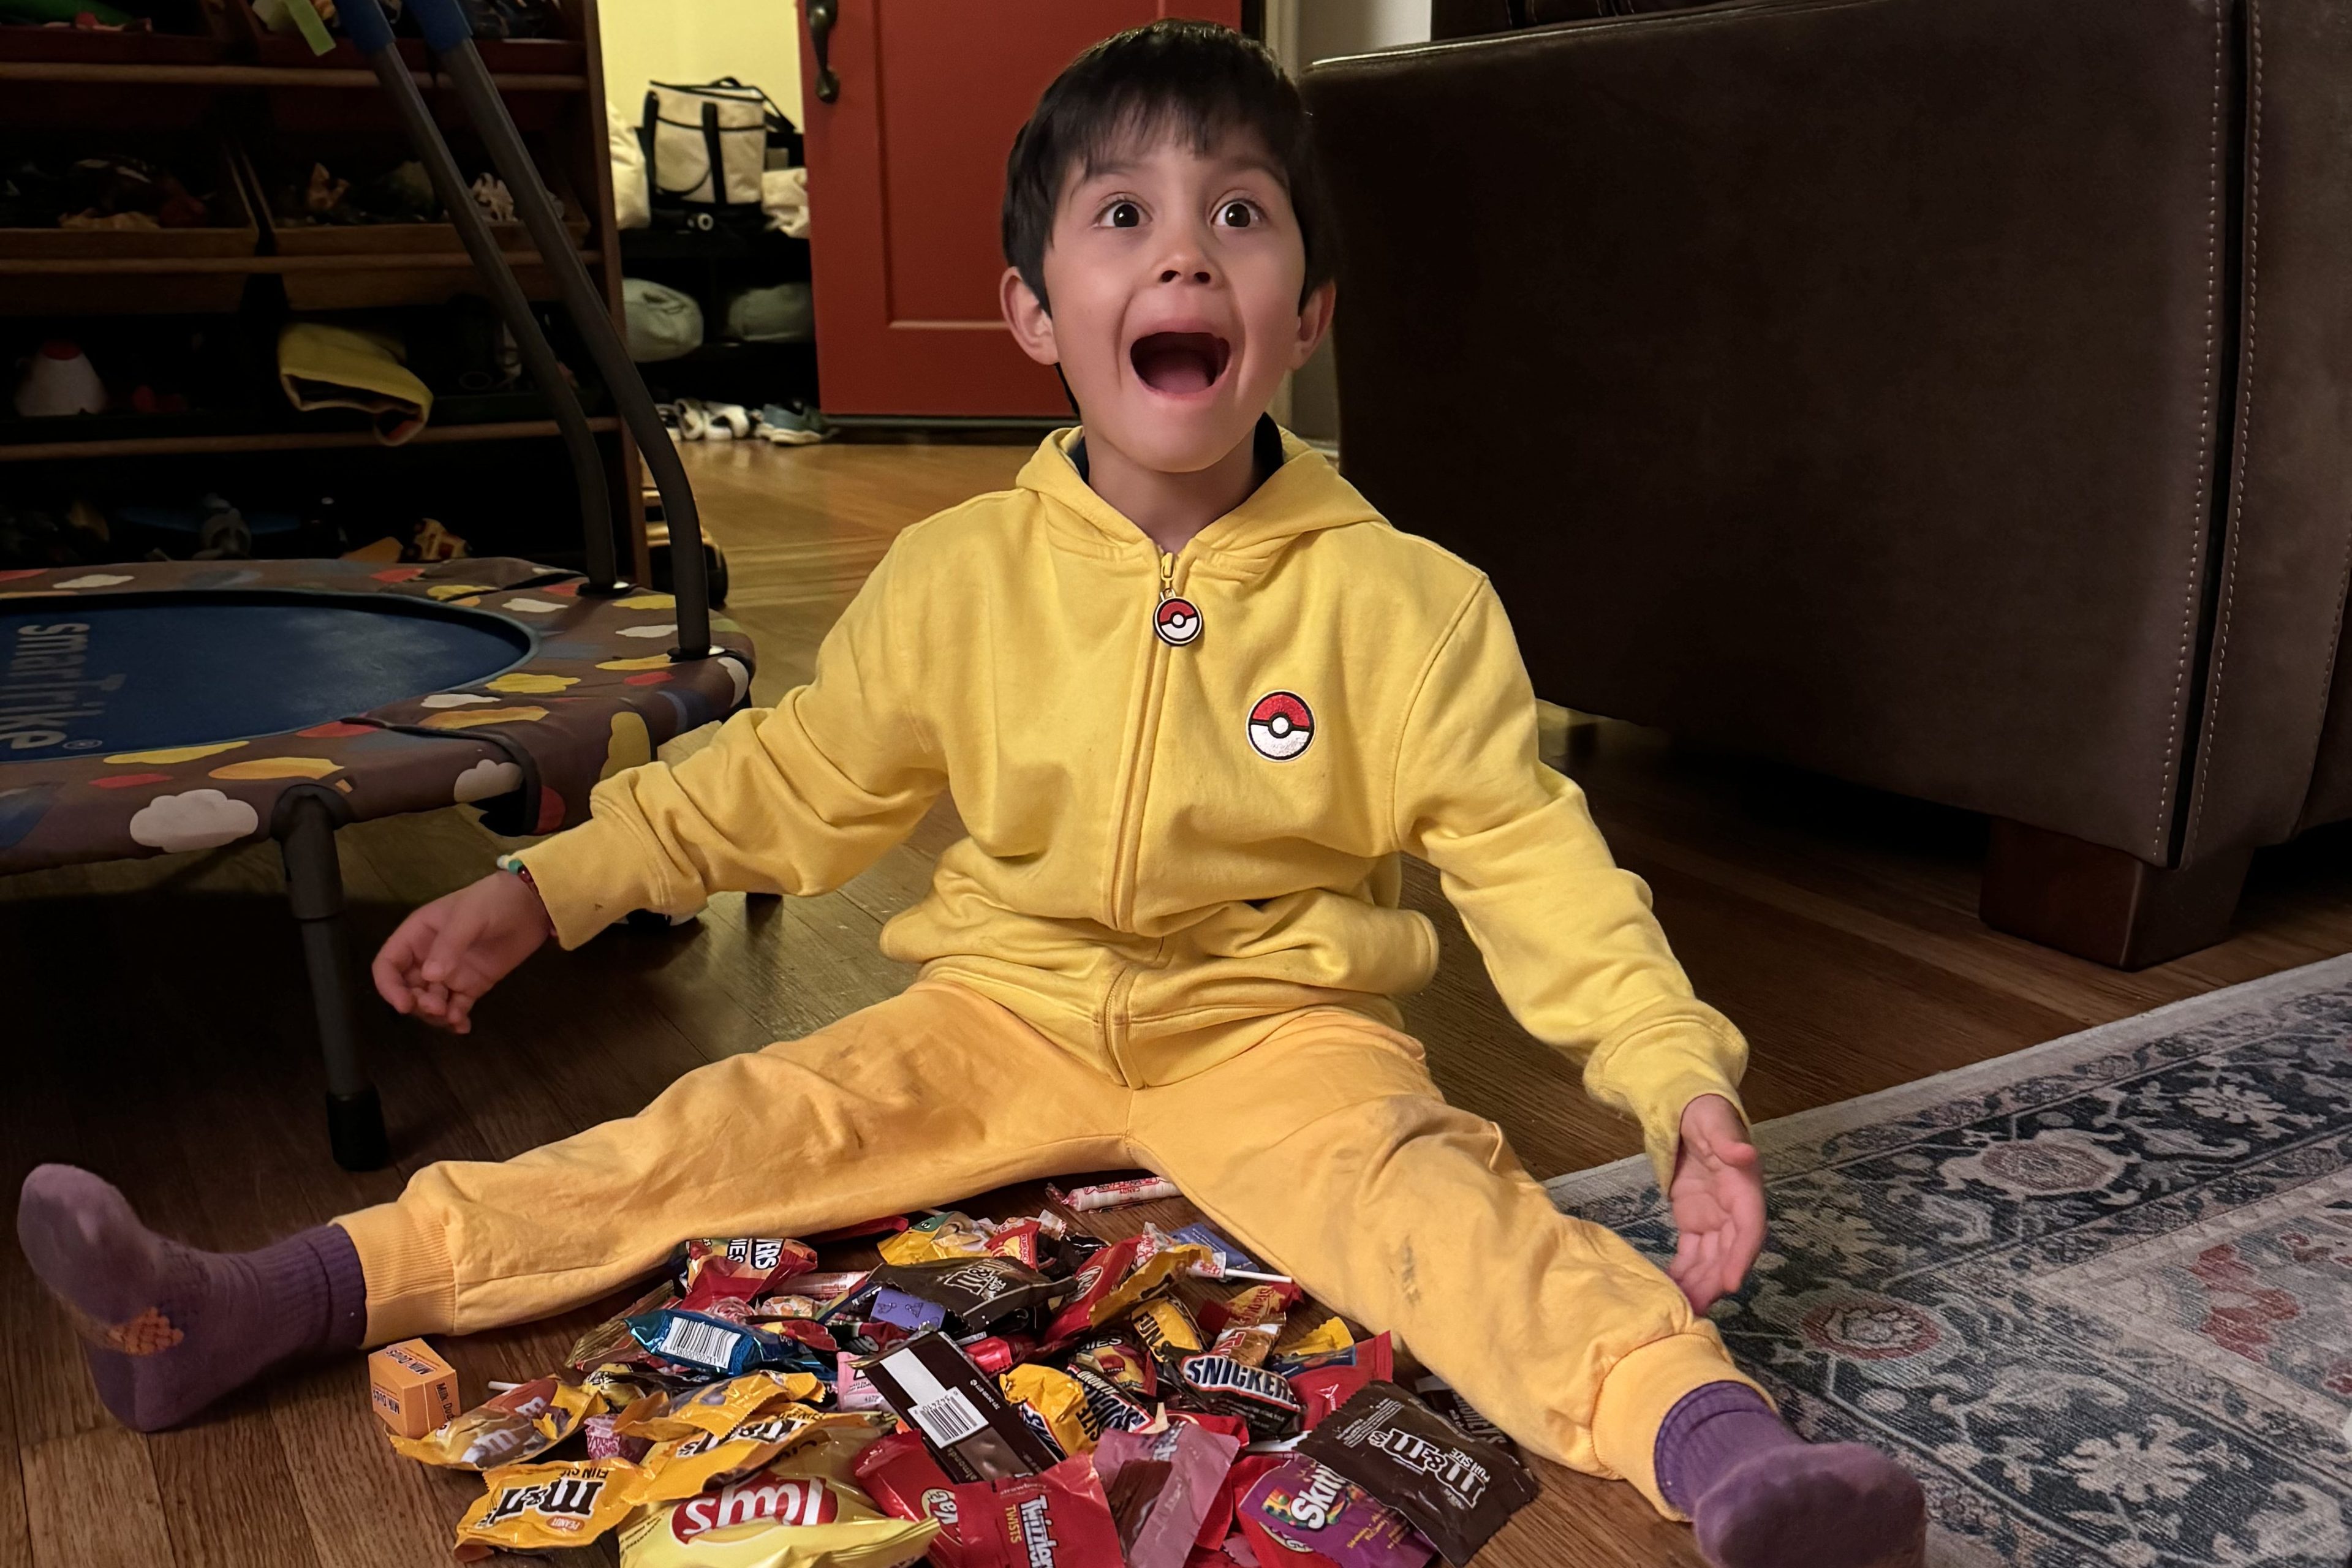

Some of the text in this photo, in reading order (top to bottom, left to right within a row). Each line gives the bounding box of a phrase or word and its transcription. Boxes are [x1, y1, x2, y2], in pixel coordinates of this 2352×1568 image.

[1077, 1371, 1121, 1395] ALMOND
[1075, 1407, 1102, 1442] SIZE
[947, 1446, 978, 1481] almonds
[551, 1516, 581, 1530] PEANUT
[1005, 1504, 1023, 1544] TWISTS
